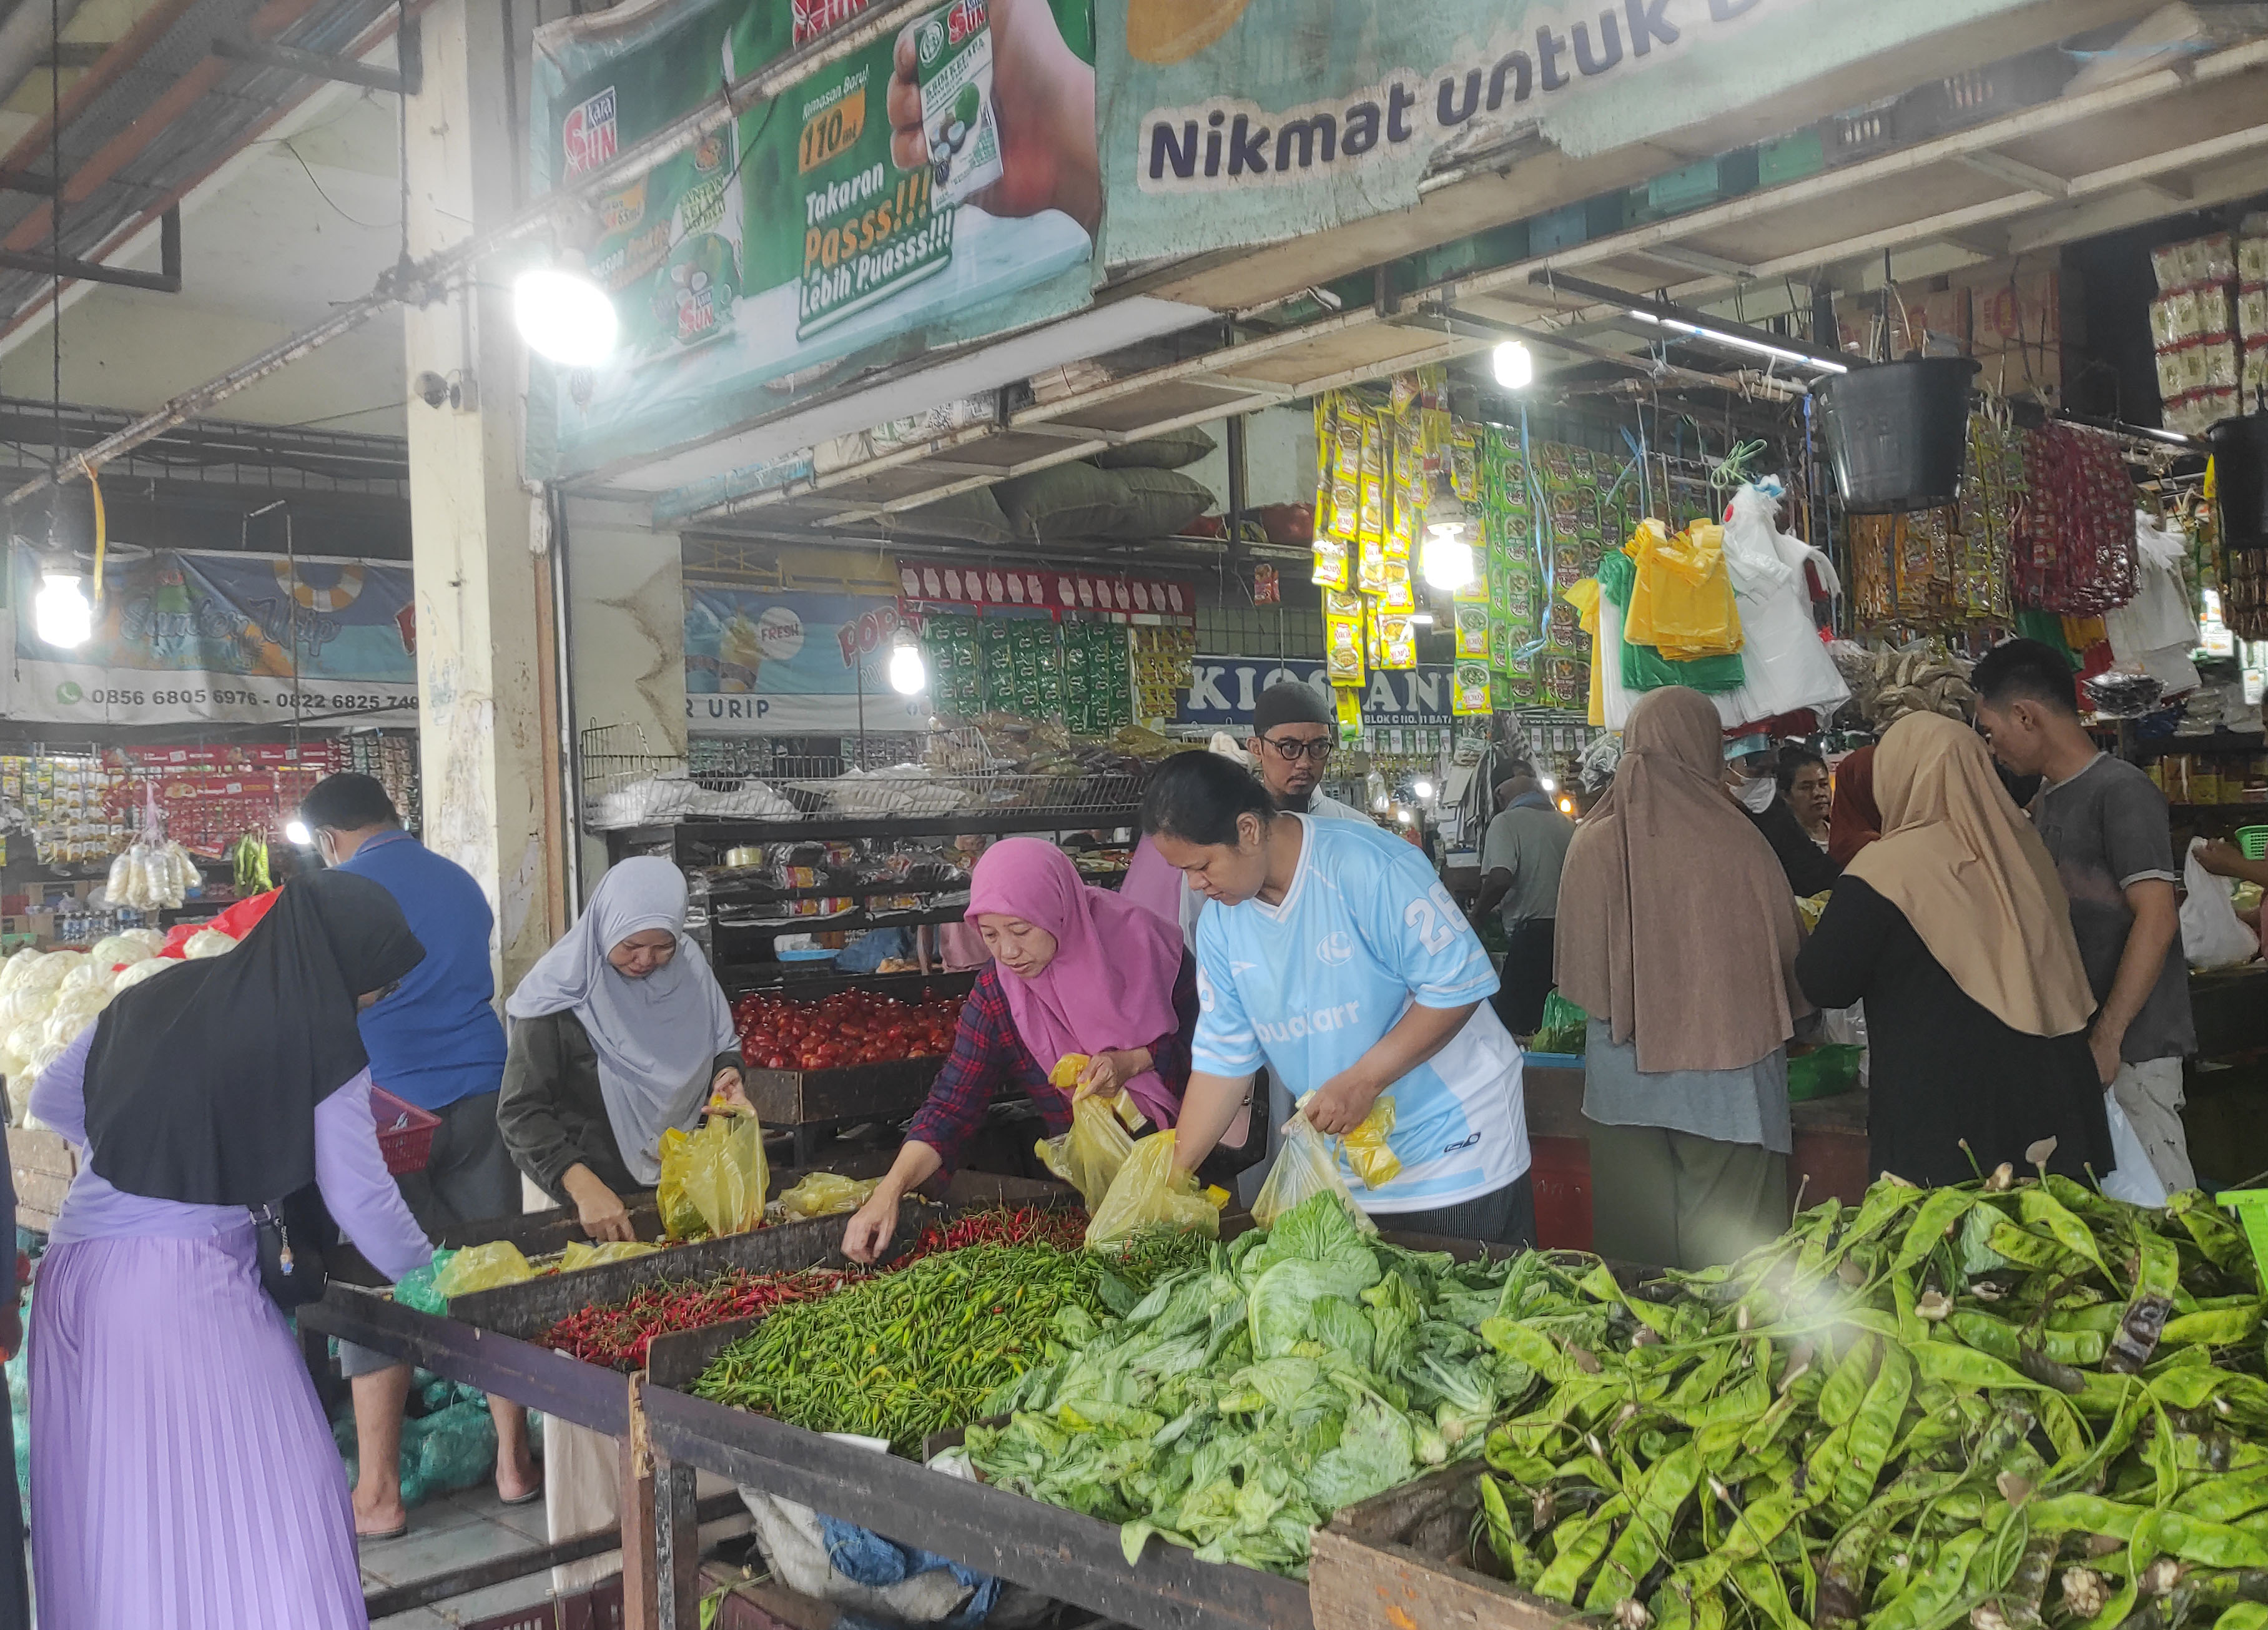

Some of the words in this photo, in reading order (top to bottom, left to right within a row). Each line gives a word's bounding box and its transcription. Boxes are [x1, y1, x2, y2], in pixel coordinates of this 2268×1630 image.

[1149, 84, 1414, 179] Nikmat
[1436, 0, 1681, 126] untuk
[805, 107, 843, 160] 110
[803, 165, 932, 280] Passs!!!
[806, 161, 884, 226] Takaran
[801, 262, 851, 319] Lebih
[855, 208, 953, 291] Puasss!!!
[761, 623, 800, 642] FRESH
[92, 689, 145, 705] 0856
[152, 689, 207, 705] 6805
[212, 689, 257, 706] 6976
[276, 693, 326, 708] 0822
[332, 694, 380, 709] 6825
[708, 698, 770, 719] URIP
[1364, 714, 1390, 724] BLOK
[1403, 879, 1470, 957] 26
